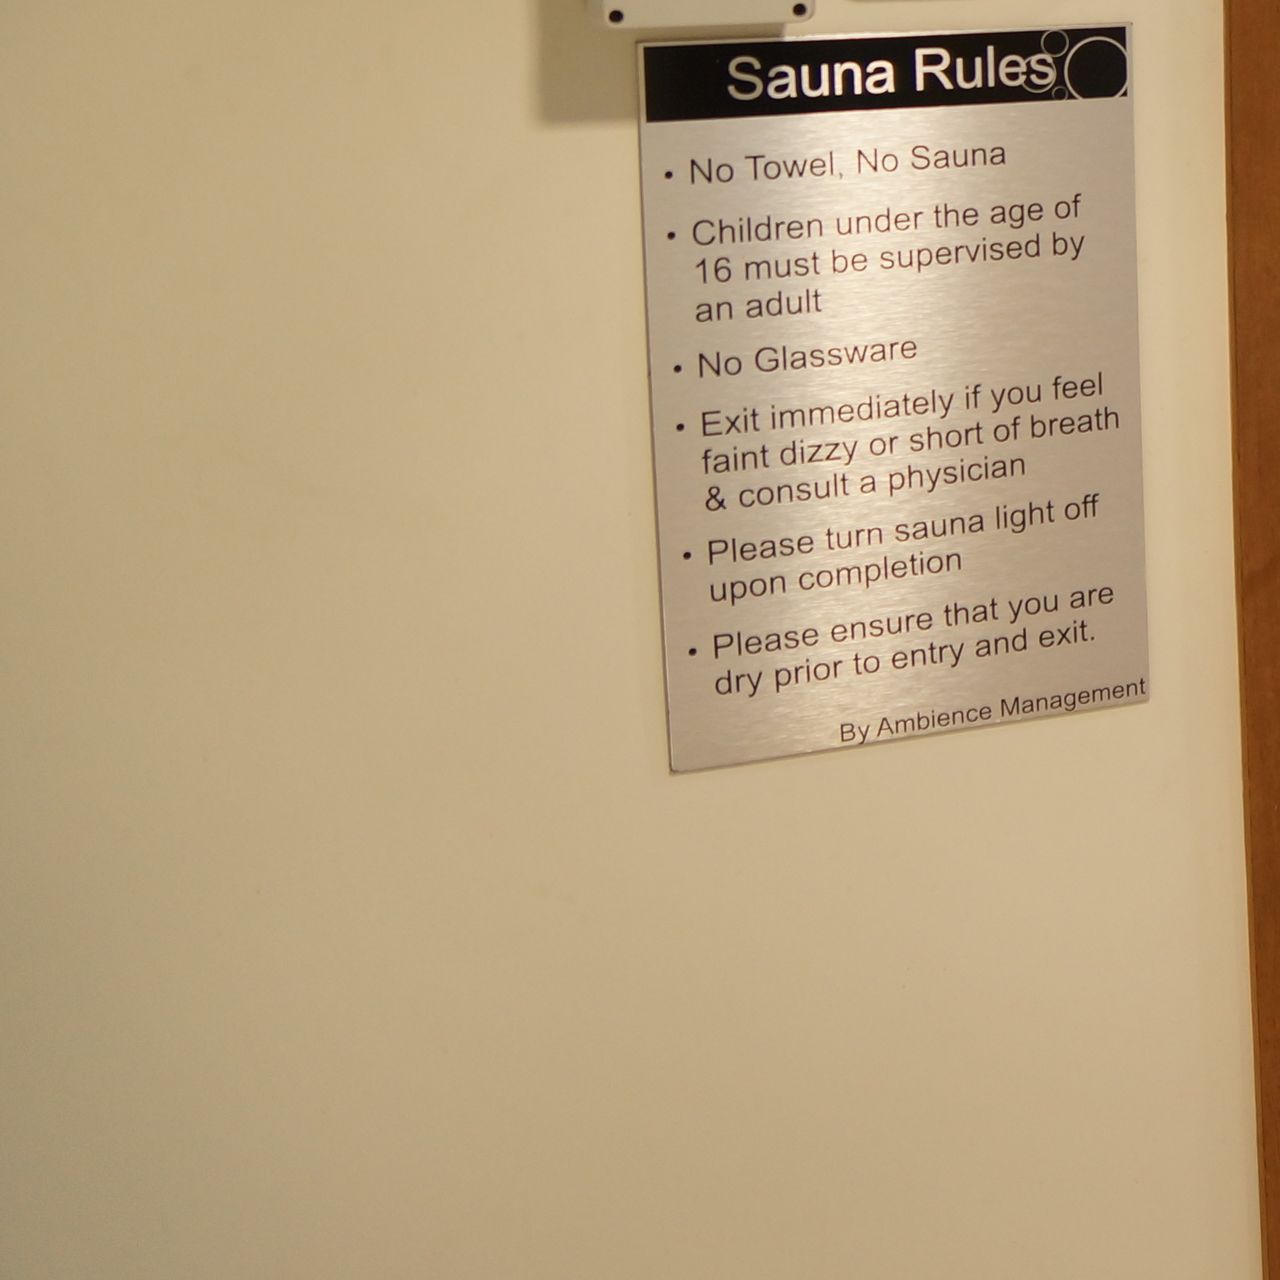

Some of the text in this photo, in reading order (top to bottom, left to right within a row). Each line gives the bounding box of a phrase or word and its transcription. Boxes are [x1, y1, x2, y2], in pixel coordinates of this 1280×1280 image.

[726, 45, 1057, 101] Sauna Rules
[690, 145, 1005, 184] No Towel, No Sauna
[693, 193, 1082, 246] Children under the age of
[696, 232, 1085, 284] 16 must be supervised by
[696, 288, 822, 322] an adult
[699, 340, 917, 378] No Glassware
[702, 371, 1102, 436] Exit immediately if you feel
[702, 406, 1119, 474] faint dizzy or short of breath
[705, 456, 1025, 511] & consult a physician
[708, 493, 1099, 565] Please turn sauna light off
[710, 551, 961, 606] upon completion
[714, 587, 1113, 663] Please ensure that you are
[715, 620, 1094, 698] dry prior to entry and exit.
[839, 678, 1147, 745] By Ambience Management
